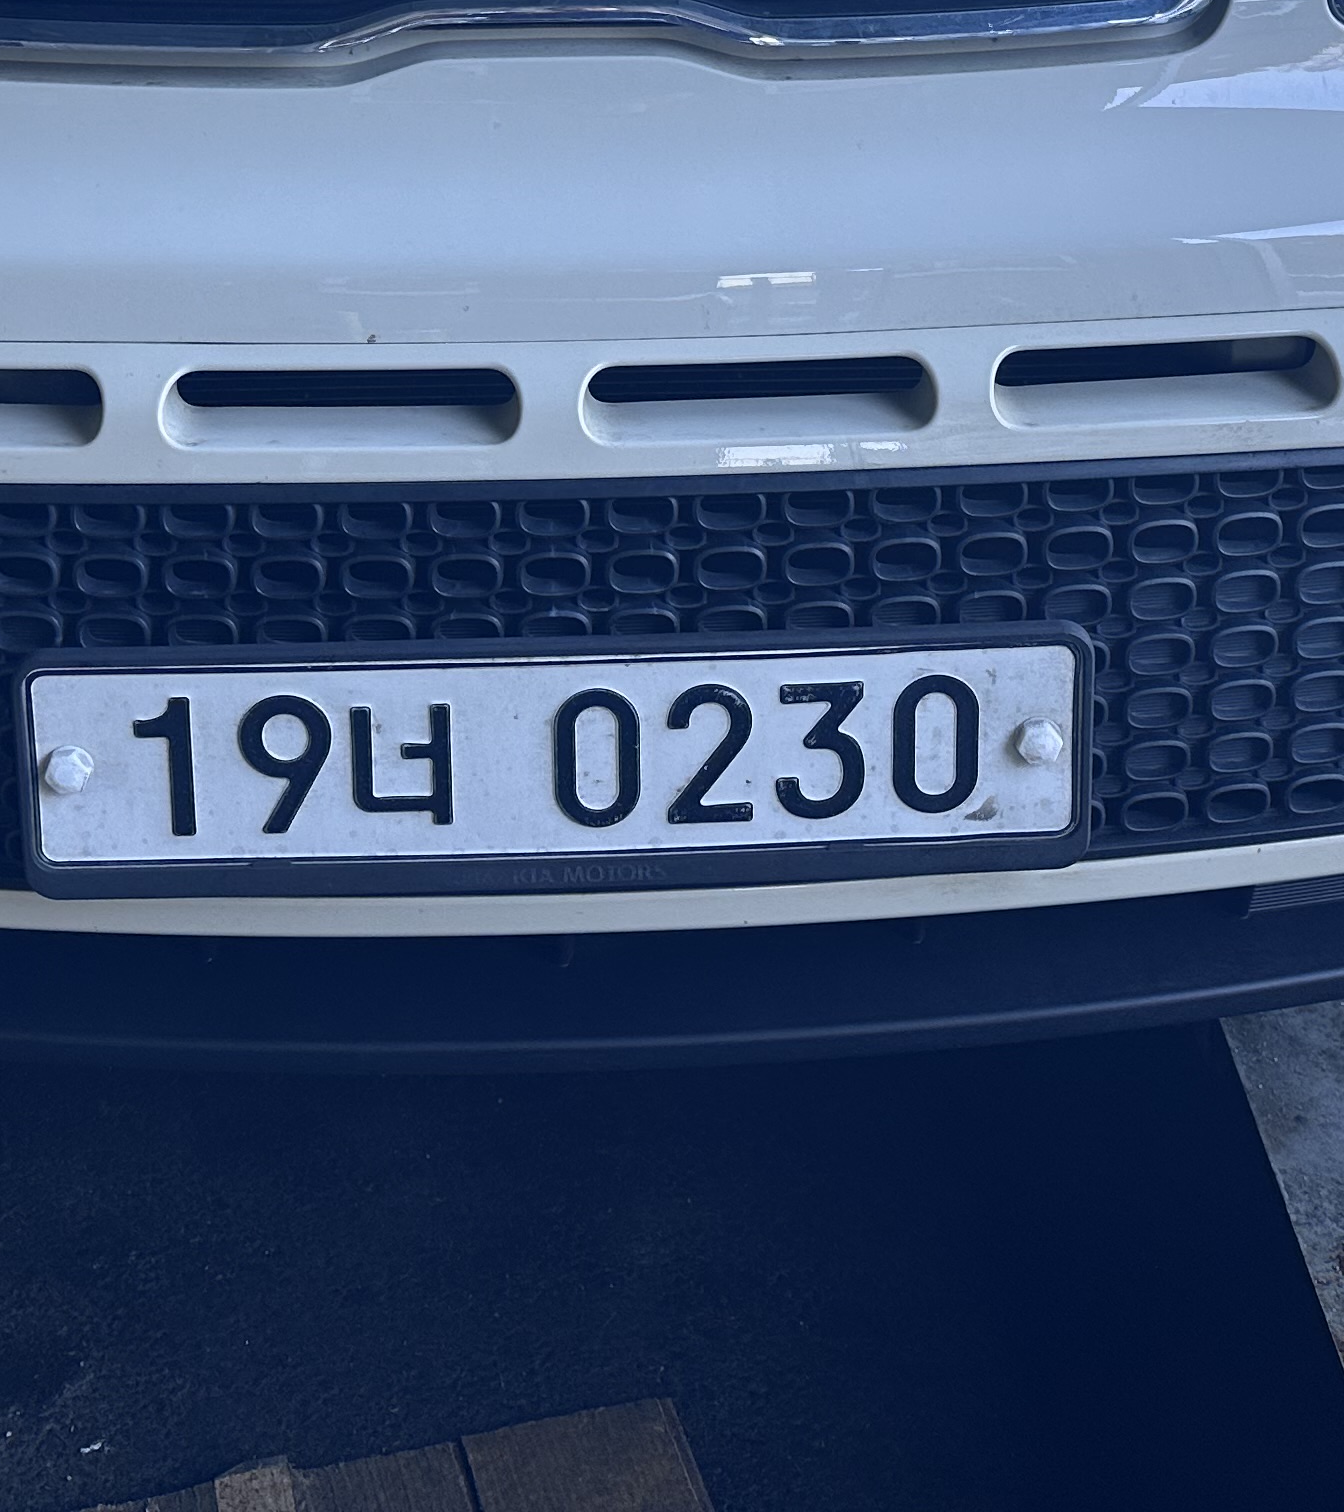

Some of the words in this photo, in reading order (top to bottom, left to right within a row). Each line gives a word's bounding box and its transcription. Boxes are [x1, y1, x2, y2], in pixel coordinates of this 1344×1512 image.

[133, 693, 453, 837] 19너
[553, 674, 980, 829] 0230
[512, 867, 554, 885] KIA
